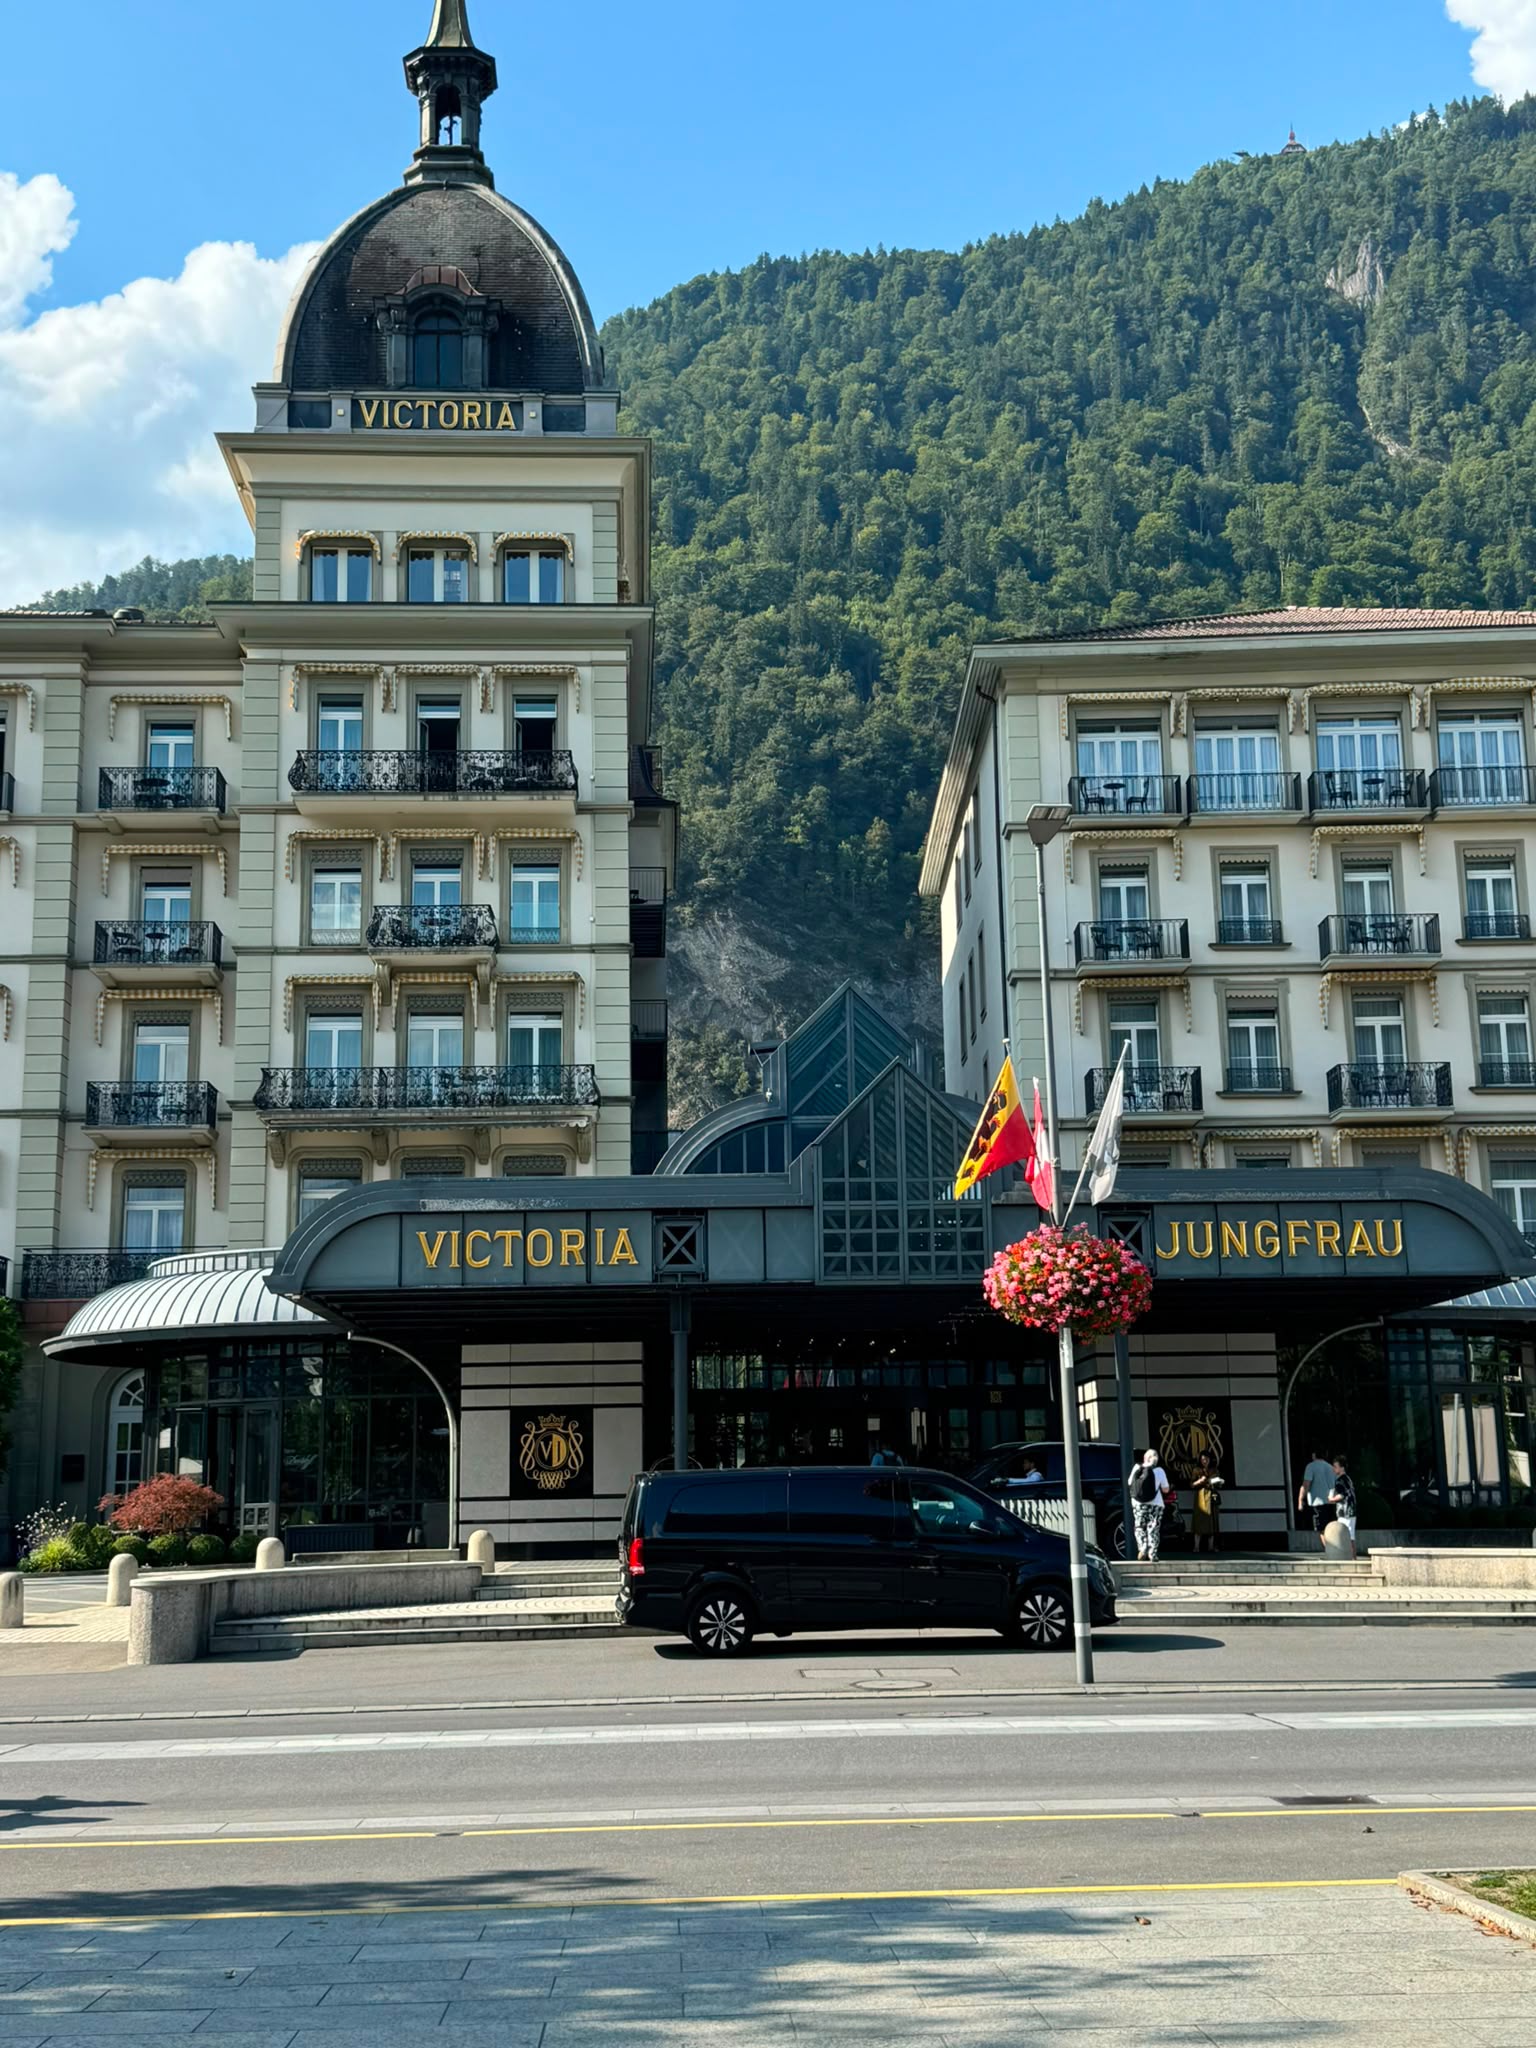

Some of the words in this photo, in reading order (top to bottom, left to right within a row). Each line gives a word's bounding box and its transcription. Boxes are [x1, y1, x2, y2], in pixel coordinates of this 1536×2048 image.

[358, 400, 517, 430] VICTORIA
[416, 1228, 640, 1268] VICTORIA
[1155, 1219, 1404, 1260] JUNGFRAU
